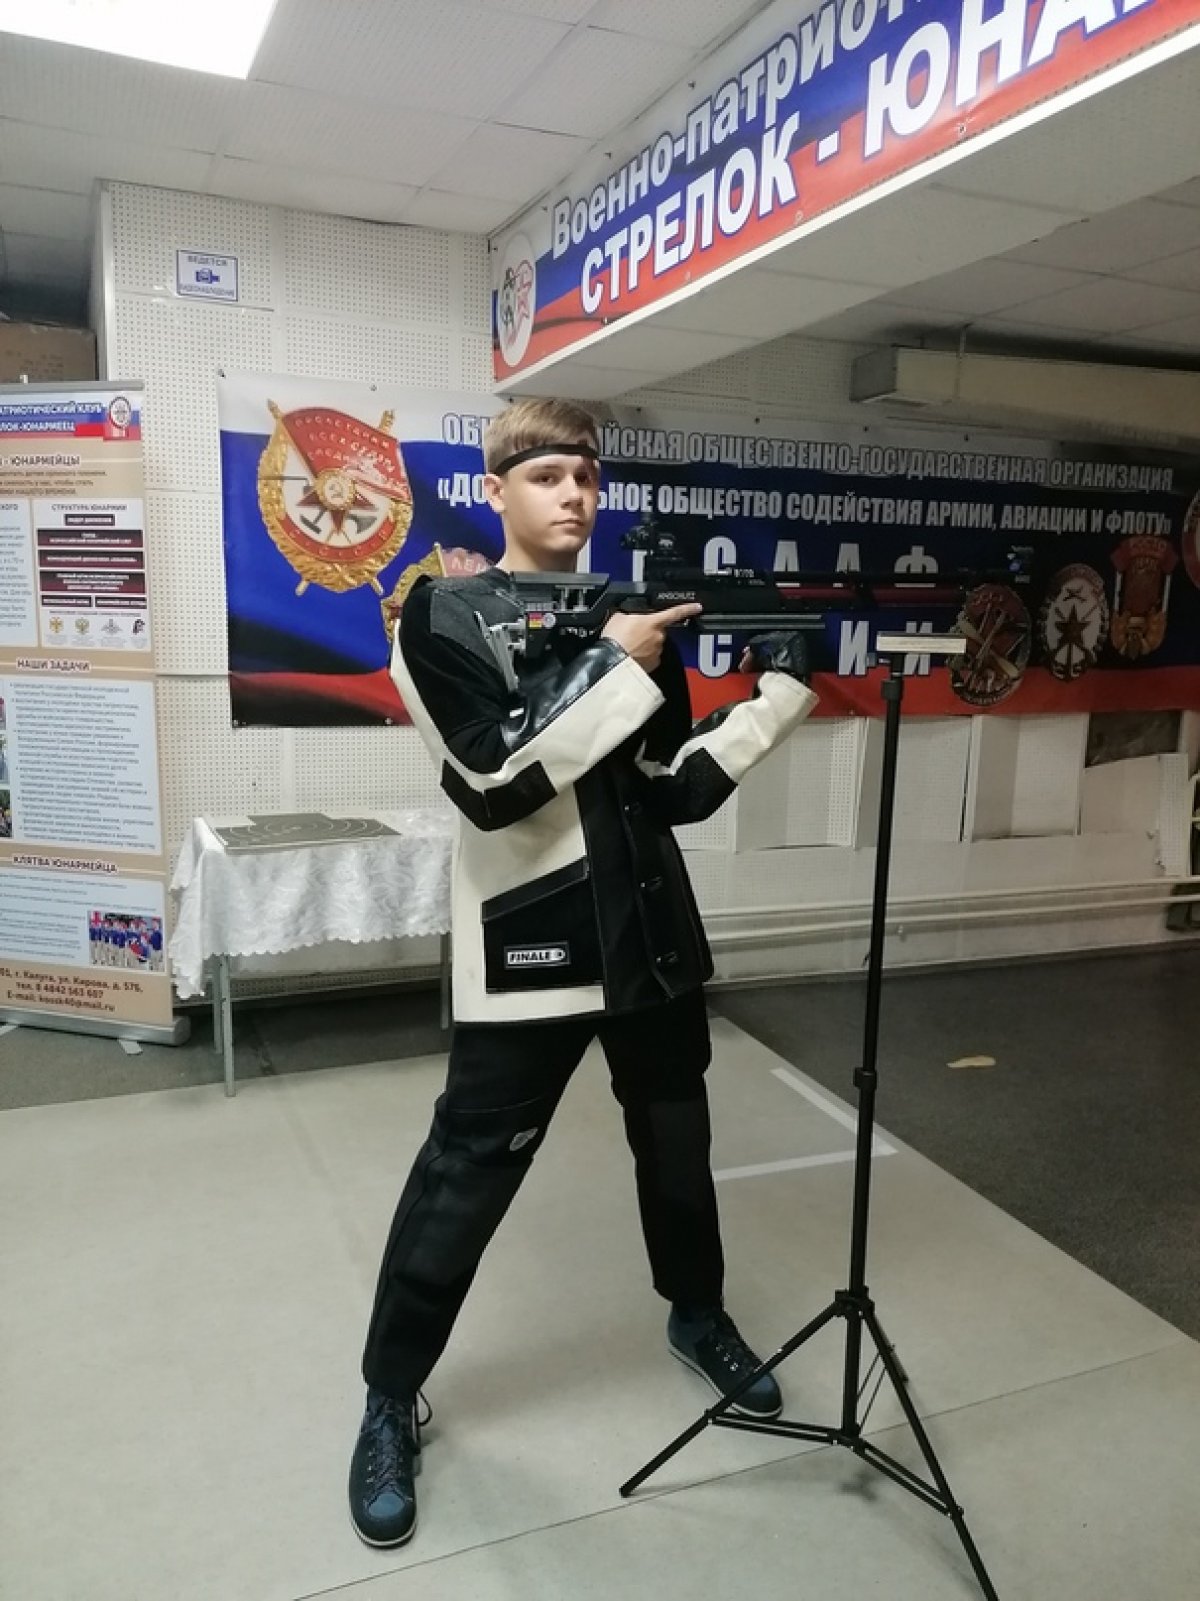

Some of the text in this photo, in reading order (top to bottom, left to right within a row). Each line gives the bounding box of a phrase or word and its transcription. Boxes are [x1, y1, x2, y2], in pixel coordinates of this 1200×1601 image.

[581, 111, 799, 315] СТРЕЛОК
[817, 130, 839, 162] -
[689, 433, 1048, 485] ОБЩЕСТВЕННО-ГОСУДАРСТВЕННАЯ
[1051, 460, 1173, 491] ОРГАНИЗАЦИЯ
[658, 485, 782, 520] ОБЩЕСТВО
[786, 490, 921, 527] СОДЕЙСТВИЯ
[926, 501, 997, 531] АРМИИ,
[1000, 505, 1086, 535] АВИАЦИИ
[1090, 510, 1103, 532] И
[17, 660, 90, 672] НАШИ ЗАДАЧИ
[13, 857, 117, 872] КЛЯТВА ЮНАРМЕЙЦА
[510, 951, 550, 961] FINALE
